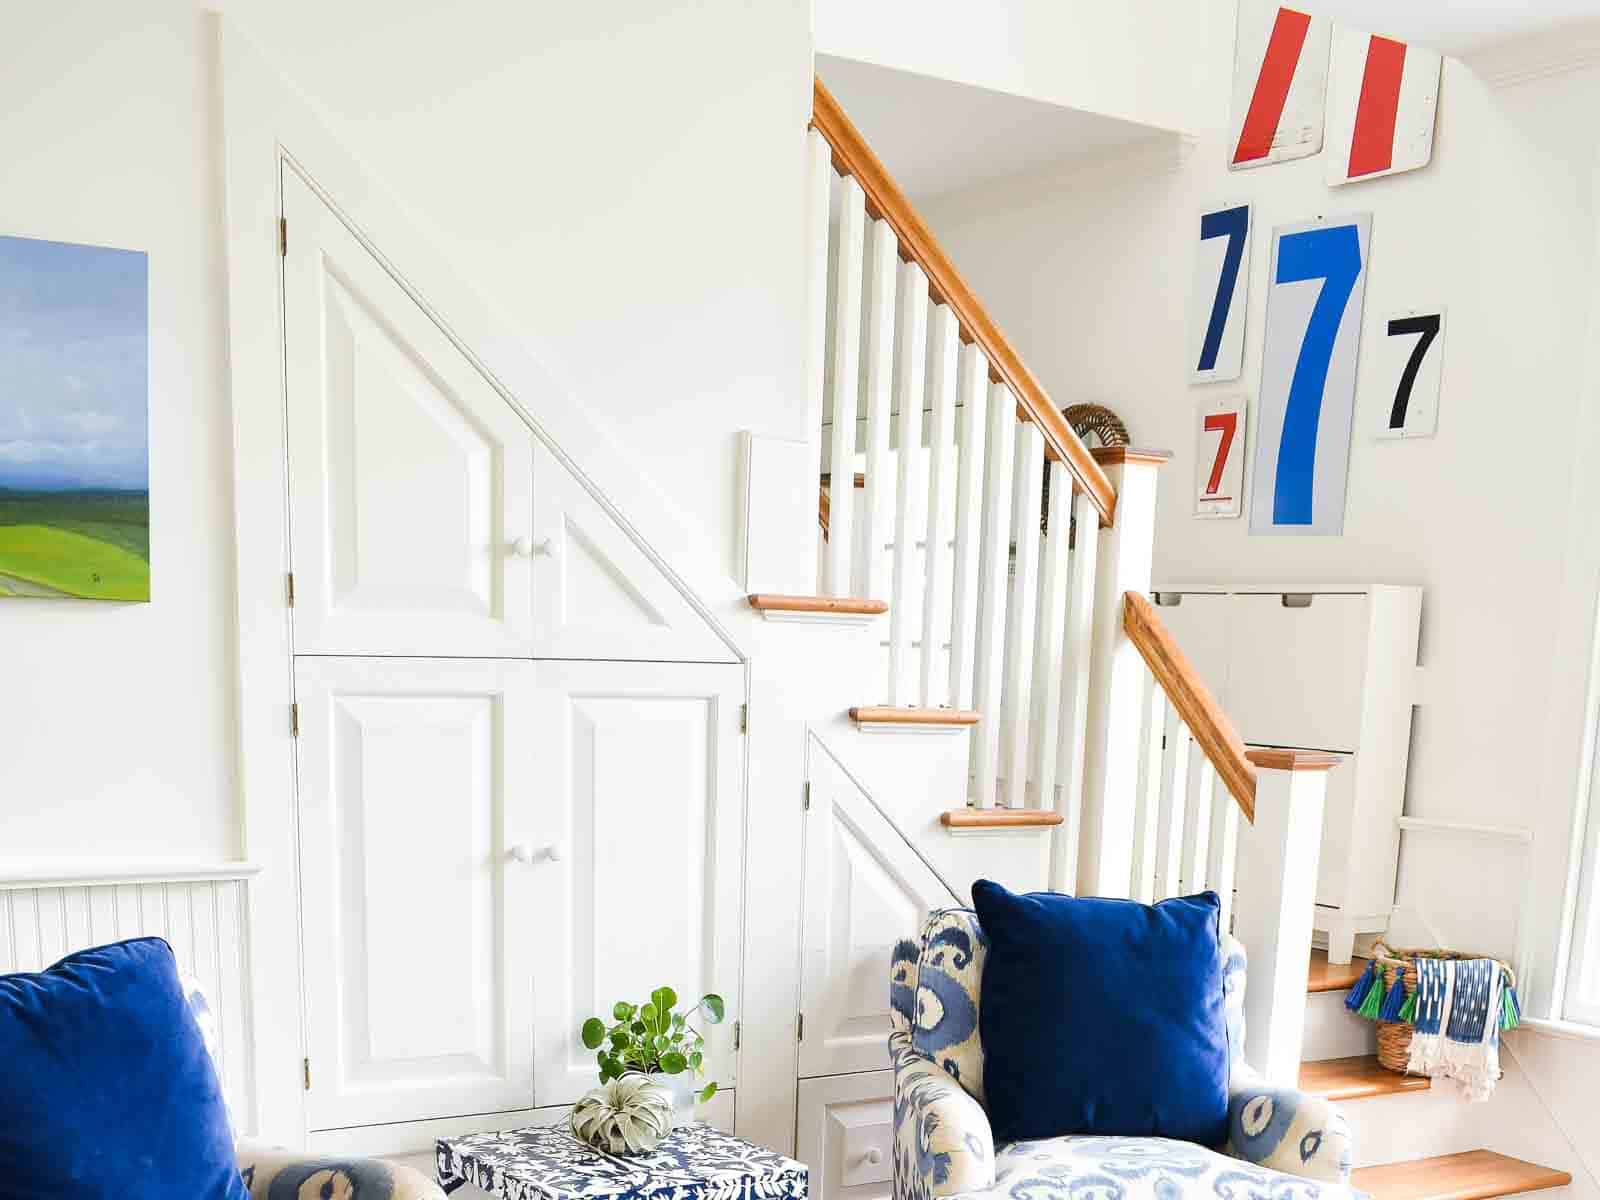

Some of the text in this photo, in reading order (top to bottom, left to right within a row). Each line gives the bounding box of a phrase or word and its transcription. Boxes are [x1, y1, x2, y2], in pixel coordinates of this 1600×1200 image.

[1197, 205, 1249, 371] 7
[1272, 224, 1361, 525] 7
[1387, 313, 1441, 429] 7
[1203, 413, 1238, 494] 7
